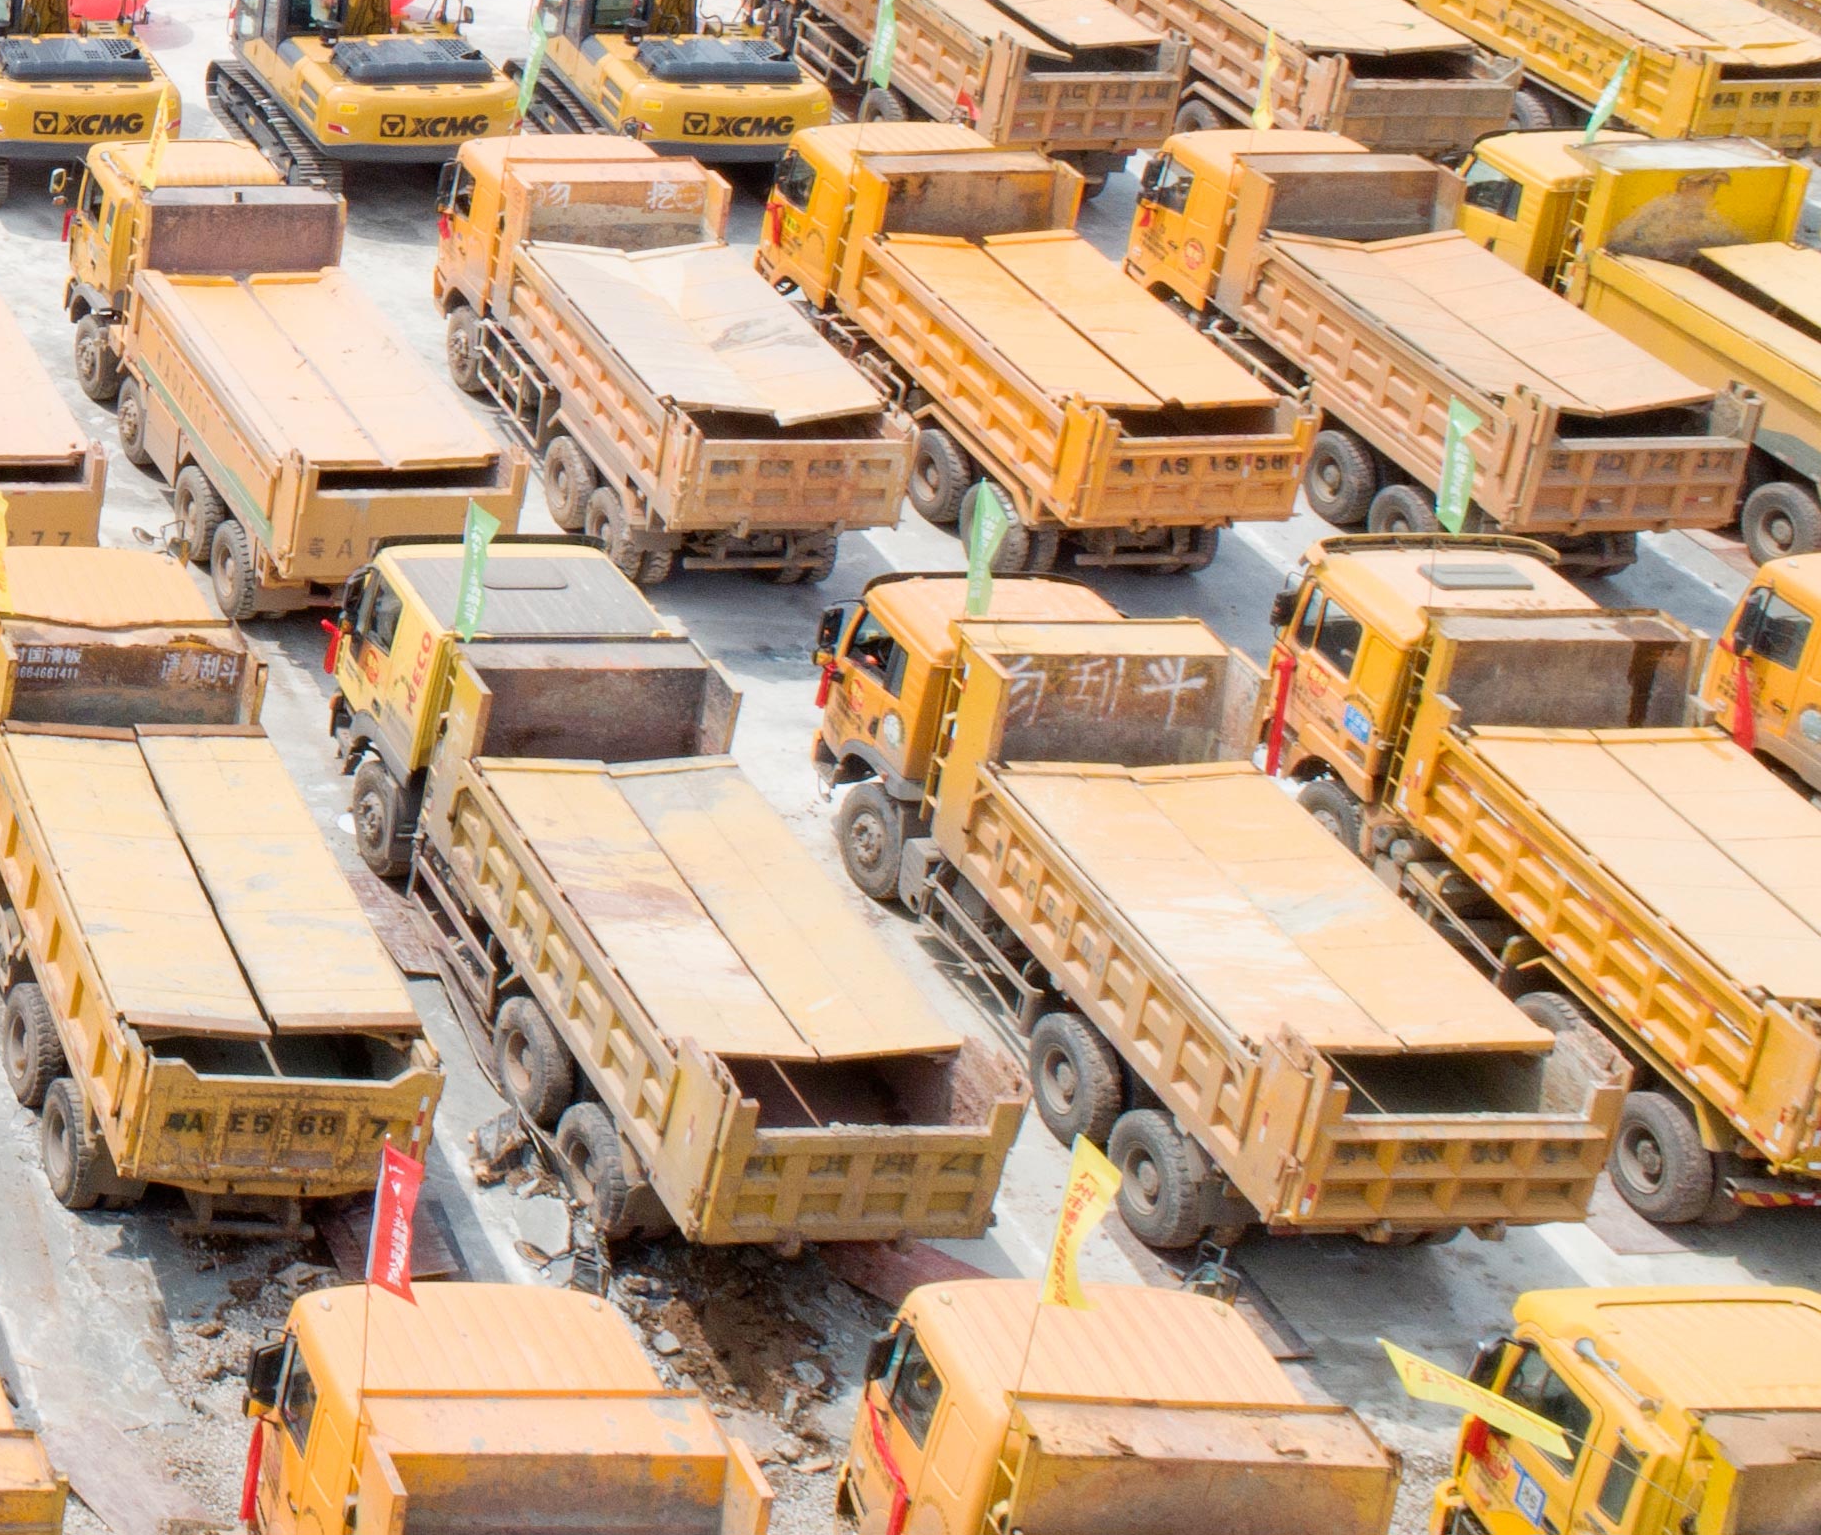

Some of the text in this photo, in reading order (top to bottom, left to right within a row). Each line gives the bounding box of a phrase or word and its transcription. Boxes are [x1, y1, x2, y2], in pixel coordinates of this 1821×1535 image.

[58, 114, 144, 136] XCMG
[411, 114, 490, 137] XCMG
[710, 114, 795, 138] XCMG
